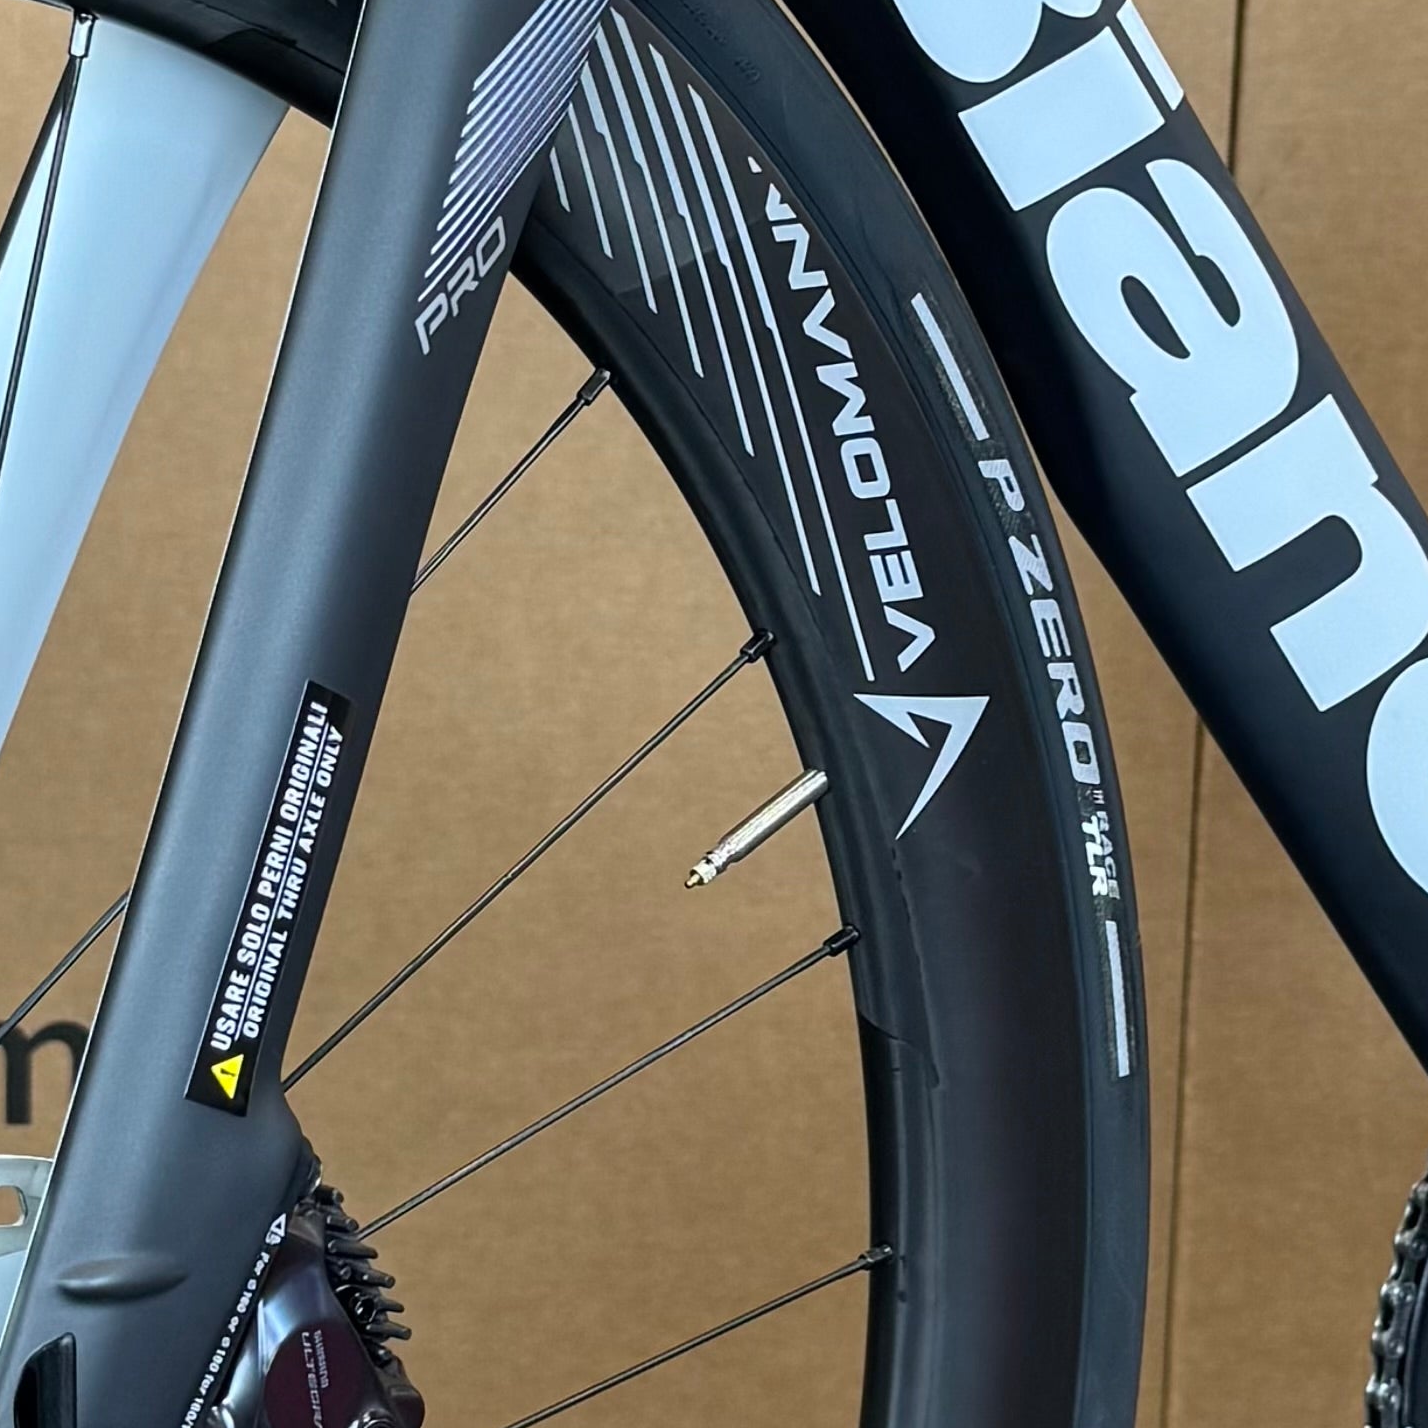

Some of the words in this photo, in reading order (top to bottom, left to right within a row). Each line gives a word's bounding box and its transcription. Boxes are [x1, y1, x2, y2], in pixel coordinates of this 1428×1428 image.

[414, 216, 506, 355] PRO
[978, 458, 1026, 512] P
[1009, 534, 1102, 785] ZERO
[210, 969, 251, 1051] USARE
[236, 902, 271, 967] SOLO
[257, 825, 294, 899] PERNI
[279, 701, 329, 822] ORIGINALI
[242, 930, 288, 1039] ORIGINAL
[276, 856, 308, 920] THRU
[298, 791, 326, 854] AXLE
[315, 725, 344, 788] ONLY
[1081, 815, 1108, 896] TLR
